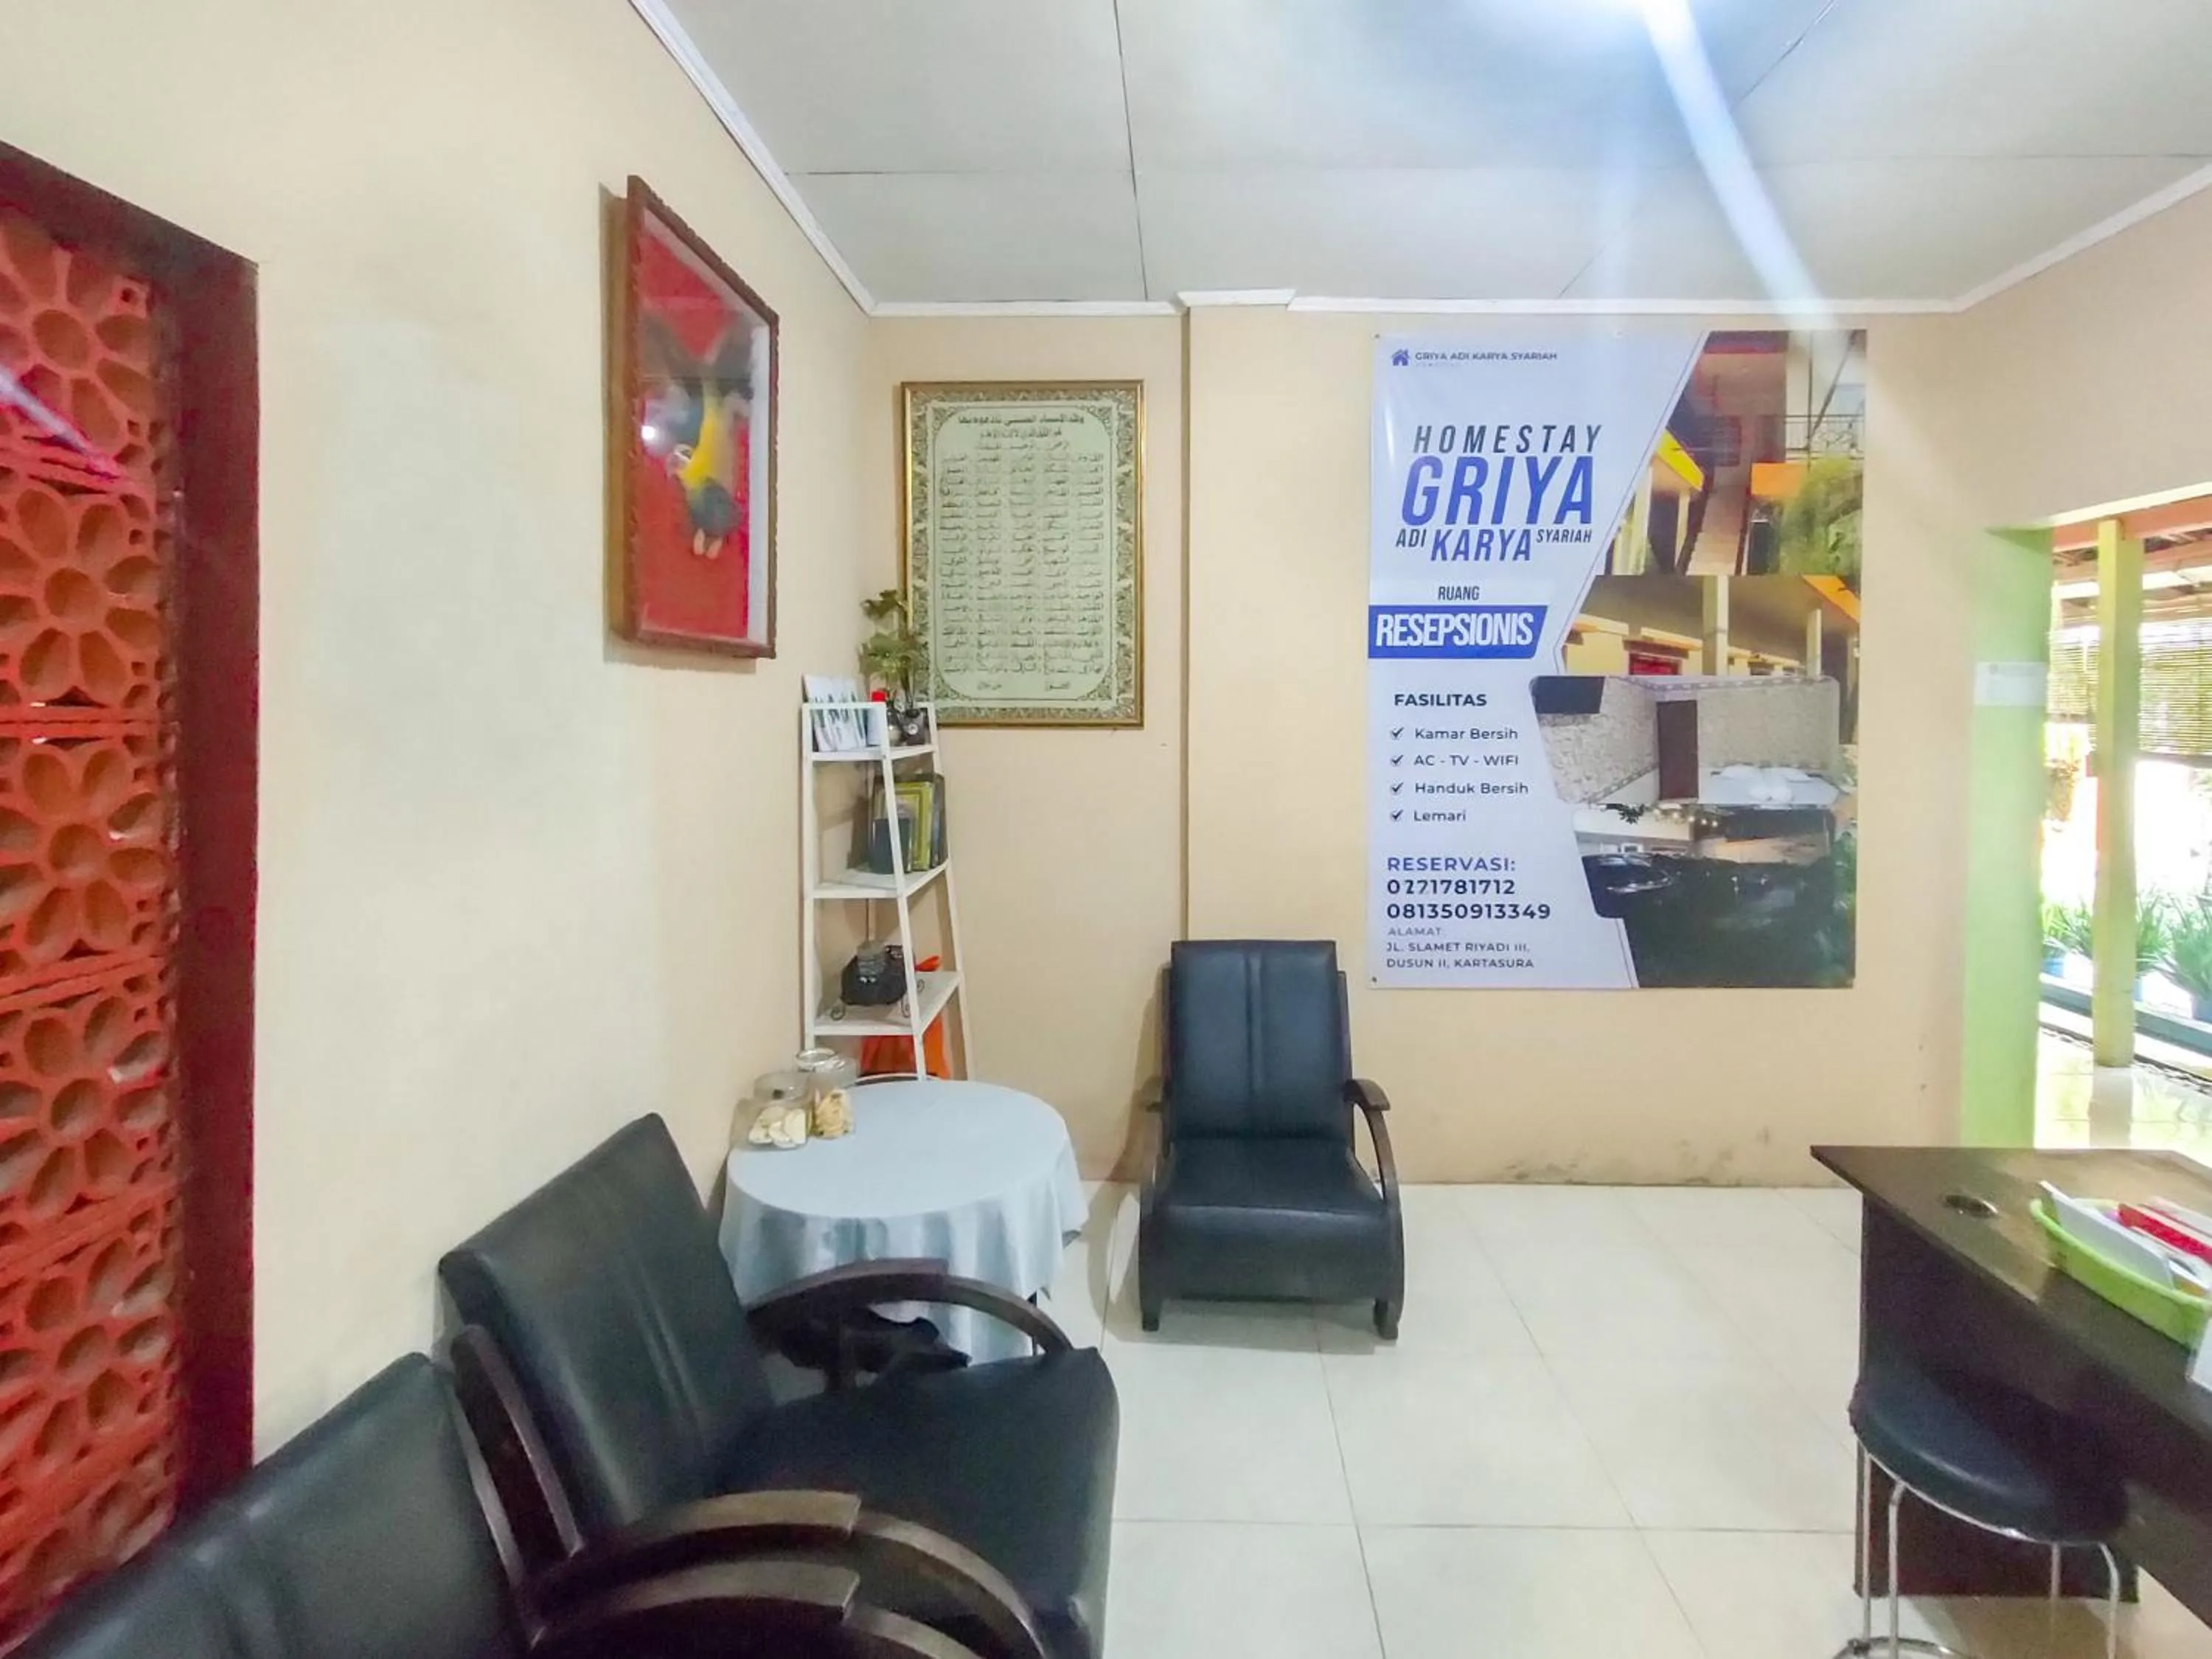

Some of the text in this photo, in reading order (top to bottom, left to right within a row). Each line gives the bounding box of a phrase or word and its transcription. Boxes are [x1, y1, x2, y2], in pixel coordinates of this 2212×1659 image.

[1415, 352, 1557, 361] GRIYA ADI KARYA SYARIAH
[1413, 425, 1602, 454] HOMESTAY
[1402, 456, 1593, 526] GRIYA
[1396, 529, 1593, 562] ADI KARYA SYARIAH
[1438, 586, 1480, 601] RUANG
[1376, 613, 1534, 648] RESEPSIONIS
[1394, 693, 1487, 707] FASILITAS
[1415, 727, 1519, 740] Kamar Bersih
[1413, 754, 1436, 766] AC
[1449, 754, 1470, 766] TV
[1483, 754, 1519, 766] WIFI
[1415, 782, 1529, 794] Handuk Bersih
[1413, 809, 1467, 821] Lemari
[1387, 857, 1516, 872] RESERVASI:
[1387, 879, 1515, 894] 0271781712
[1387, 903, 1551, 919] 081350913349
[1408, 942, 1461, 952] SLAMET
[1464, 942, 1510, 952] RIYADI
[1386, 959, 1434, 968] DUSUN
[1453, 959, 1534, 969] KARTASURA
